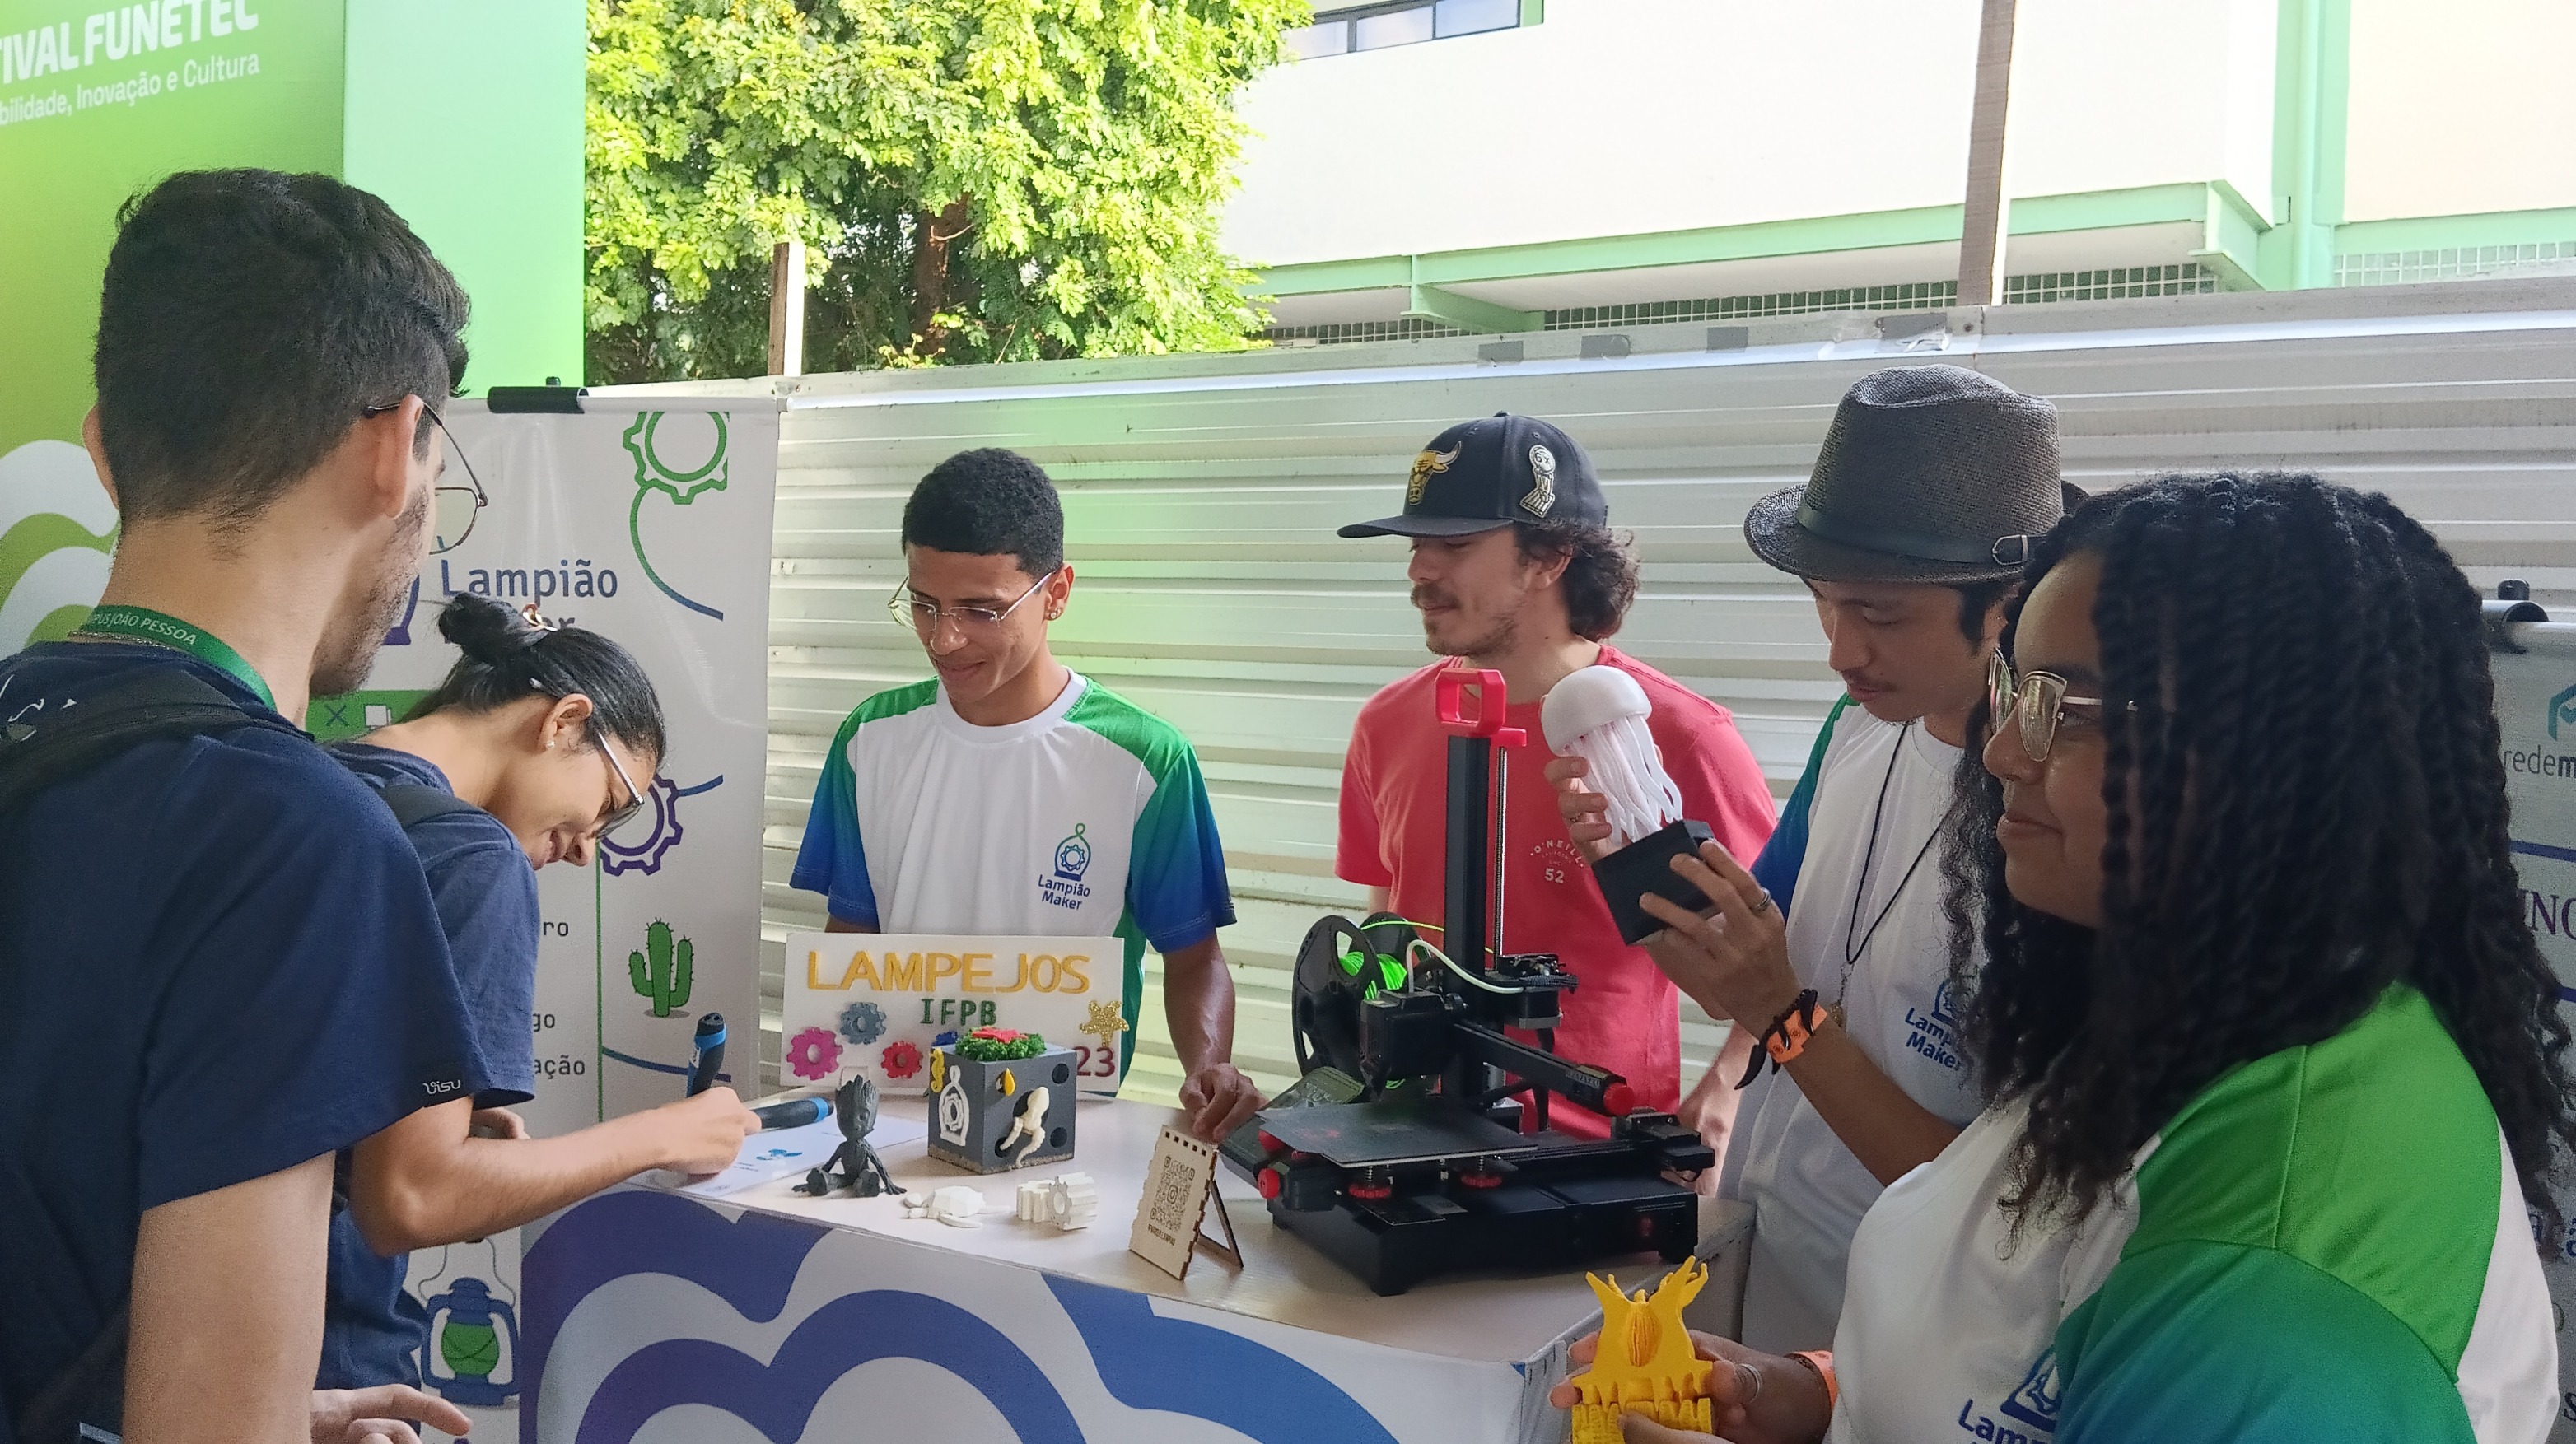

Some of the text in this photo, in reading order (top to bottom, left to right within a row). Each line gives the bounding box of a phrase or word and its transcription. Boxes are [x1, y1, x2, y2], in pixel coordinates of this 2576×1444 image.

[0, 0, 259, 84] IVAL FUNETEC
[77, 71, 161, 110] Inovação
[167, 71, 178, 91] e
[184, 53, 259, 88] Cultura
[441, 559, 618, 608] Lampião
[107, 612, 139, 627] JOÃO
[140, 617, 197, 645] PESSOA
[1038, 874, 1090, 897] Lampião
[1544, 868, 1564, 883] 52
[1041, 890, 1082, 910] Maker
[807, 950, 1091, 994] LAMPEJOS
[920, 998, 997, 1027] IFPB
